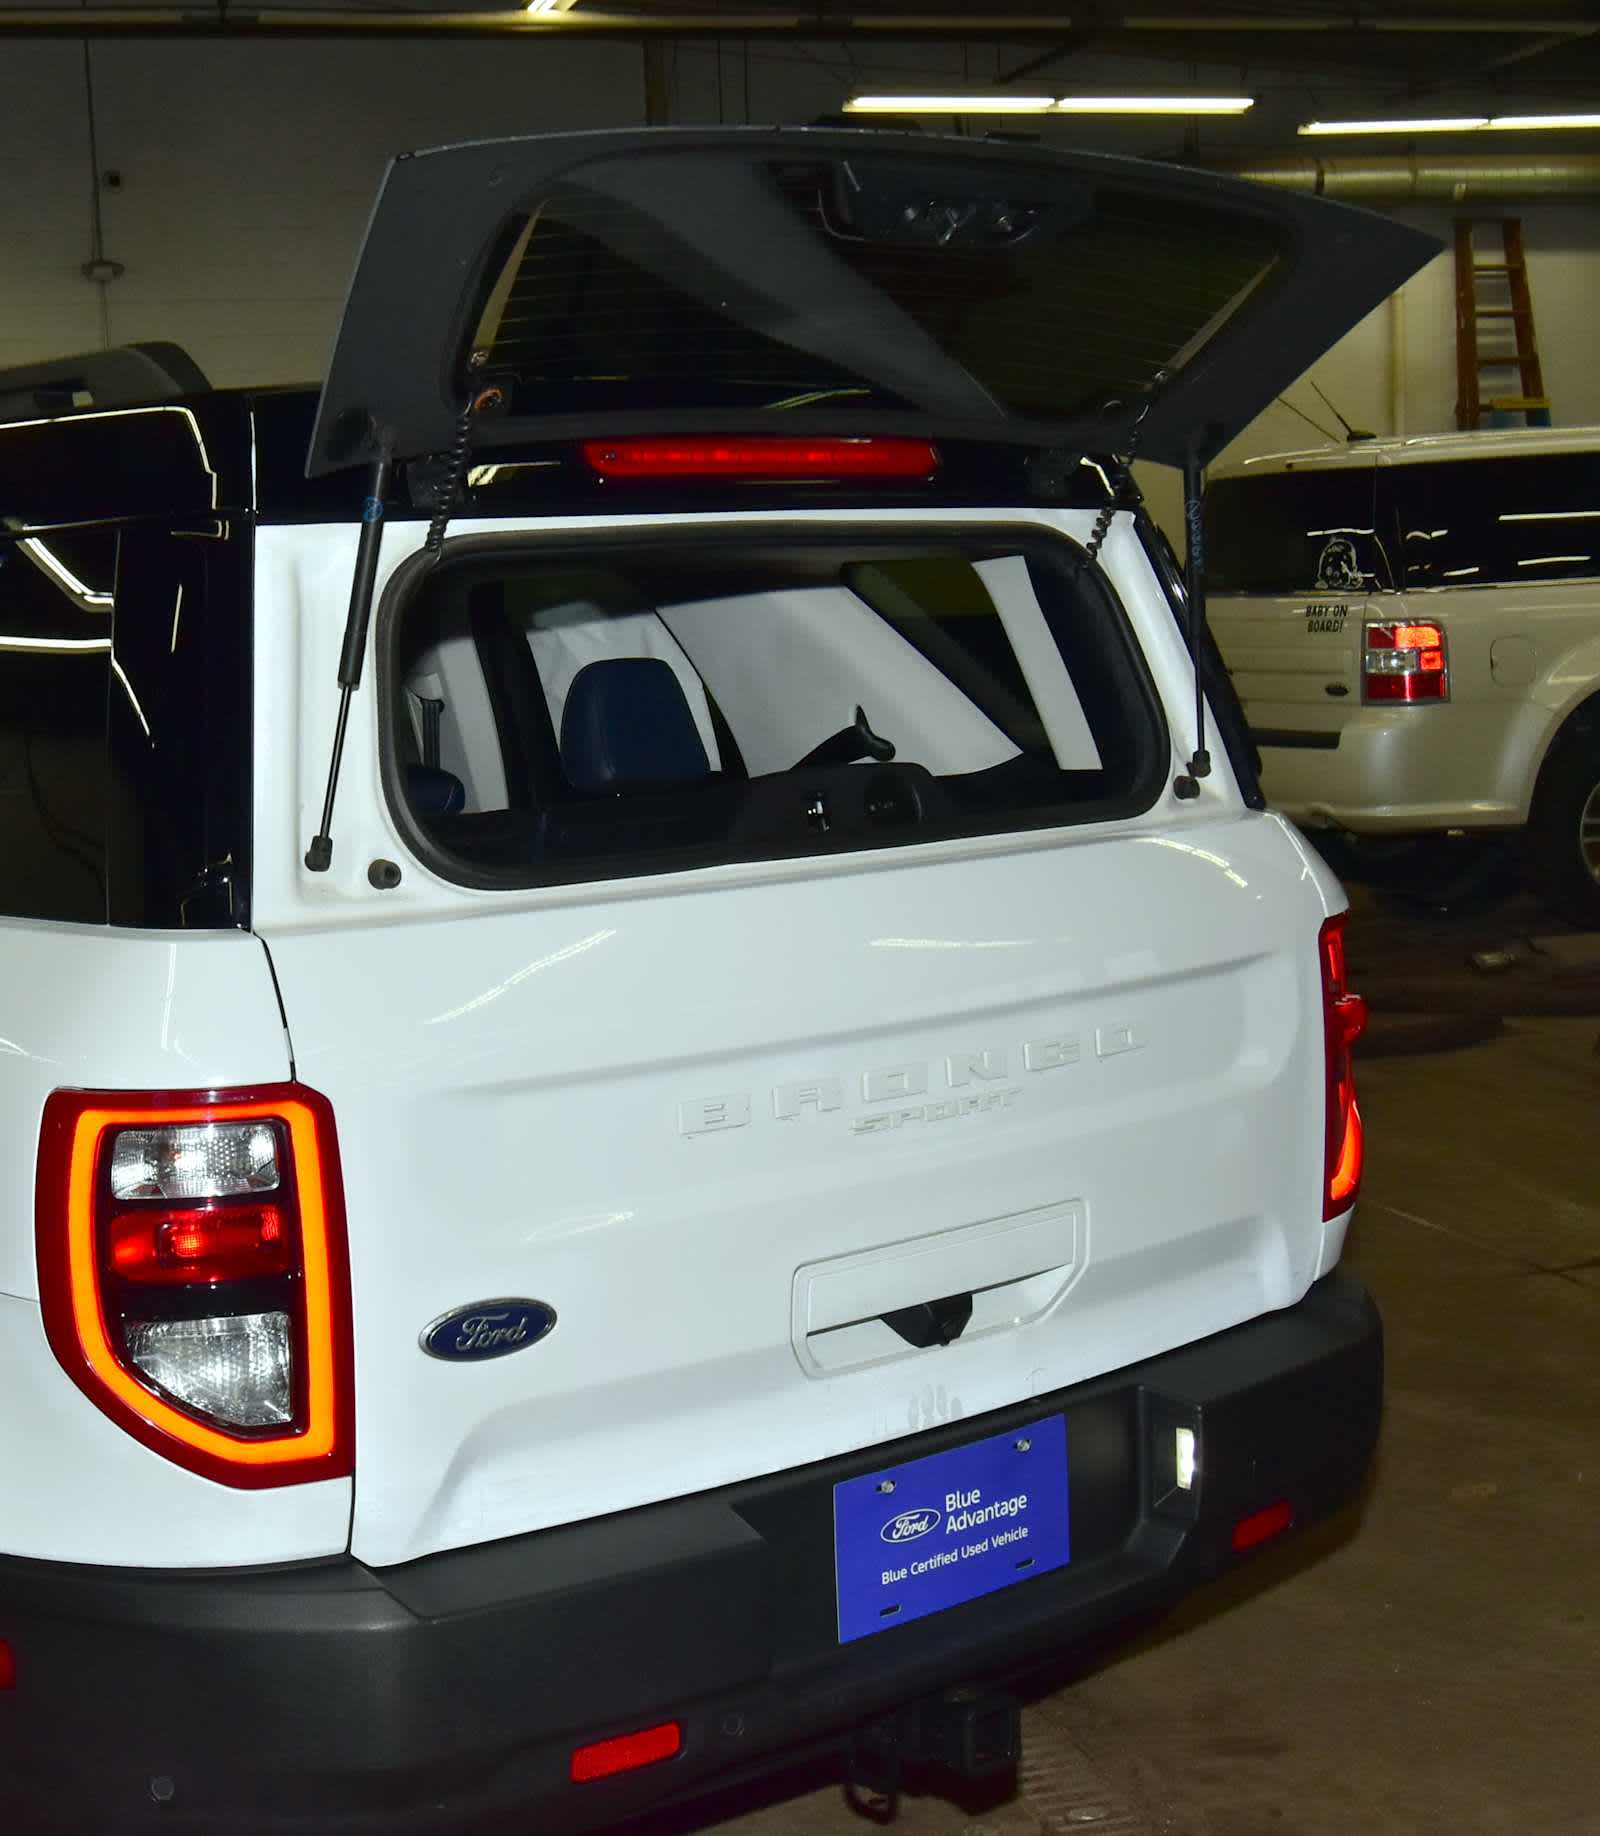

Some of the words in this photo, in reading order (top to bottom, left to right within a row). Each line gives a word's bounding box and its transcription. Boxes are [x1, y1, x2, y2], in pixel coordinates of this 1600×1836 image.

[1306, 604, 1330, 617] BABY
[1333, 604, 1348, 617] ON
[1307, 619, 1344, 633] BOARD!
[678, 1022, 1147, 1138] BRONCO
[851, 1089, 1023, 1136] SPORT
[456, 1312, 528, 1351] Ford
[945, 1488, 981, 1513] Blue
[945, 1494, 1028, 1535] Advantage
[892, 1513, 930, 1540] Ford
[881, 1567, 908, 1585] Blue
[910, 1549, 958, 1576] Certified
[961, 1538, 988, 1559] Used
[991, 1526, 1029, 1549] Vehicle
